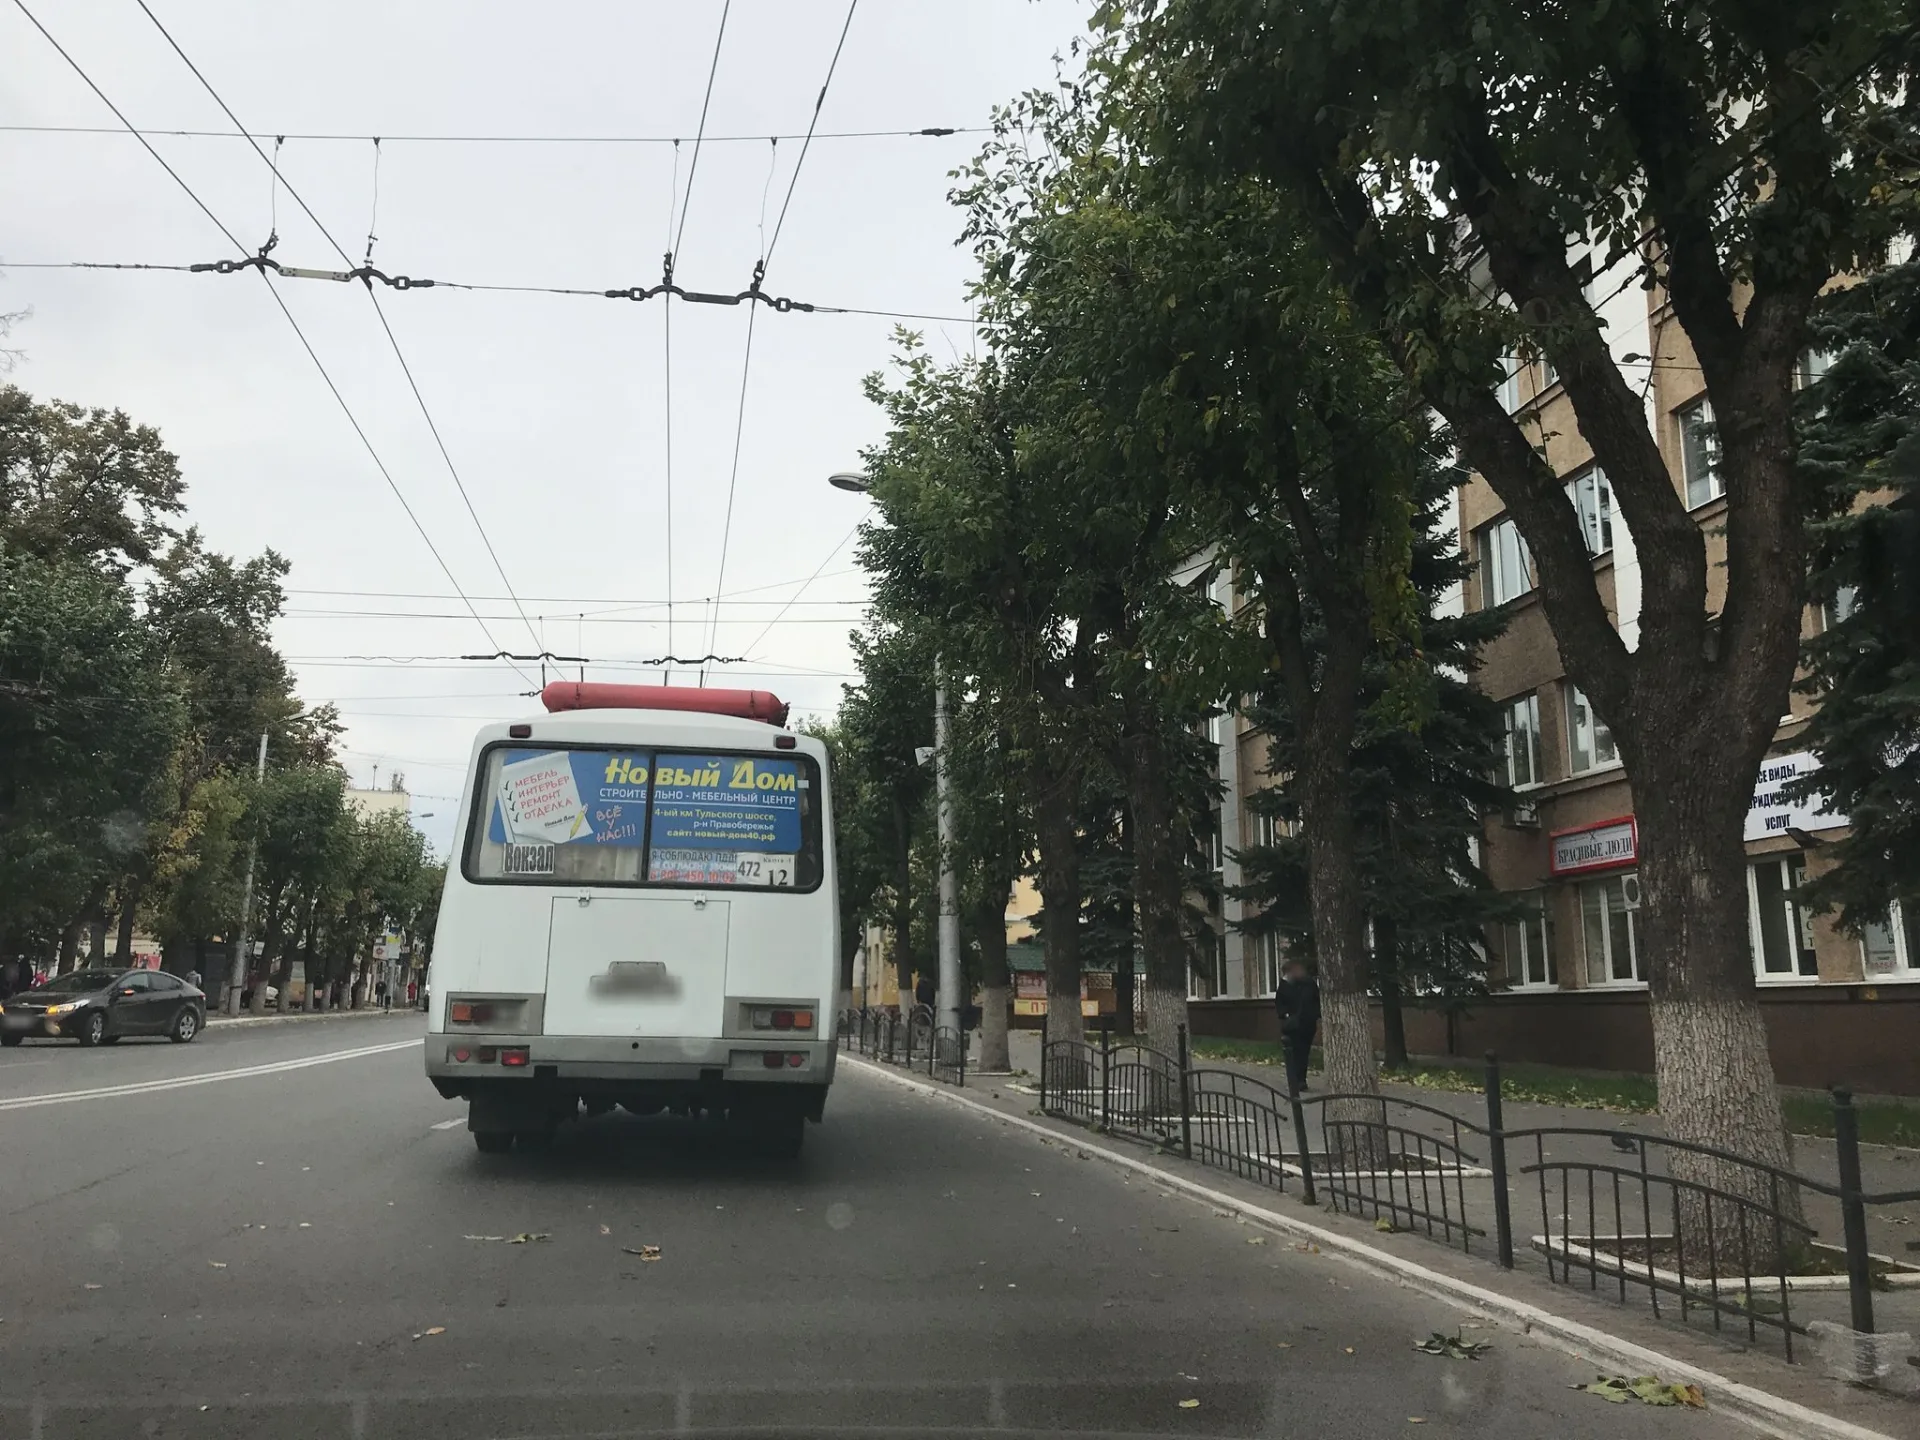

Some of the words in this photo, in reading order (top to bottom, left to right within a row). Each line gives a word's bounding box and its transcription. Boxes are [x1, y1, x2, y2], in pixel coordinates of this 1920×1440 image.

[515, 769, 558, 788] МЕБЕЛЬ
[605, 758, 720, 788] Новый
[728, 761, 796, 792] Дом
[1756, 771, 1768, 784] СЕ
[1768, 763, 1797, 781] ВИДЫ
[518, 776, 570, 798] ИНТЕРЬЕР
[600, 787, 684, 800] СТРОИТЕЛЬНО
[692, 791, 758, 803] МЕБЕЛЬНЫЙ
[762, 794, 796, 806] ЦЕНТР
[520, 790, 561, 809] РЕМОНТ
[524, 798, 573, 820] ОТДЕЛКА
[606, 819, 614, 829] У
[654, 809, 677, 818] 4-ый
[680, 810, 693, 818] км
[694, 809, 743, 821] Тульского
[745, 813, 777, 822] шоссе,
[1764, 814, 1791, 831] УСЛУГ
[596, 824, 637, 843] НАС!!!
[693, 820, 708, 829] р-н
[709, 820, 774, 831] Правобережье
[694, 831, 776, 841] новый-дом40.рф
[504, 843, 554, 872] Вокзал
[651, 850, 657, 860] Я
[659, 851, 713, 863] СОБЛЮДАЮ
[1558, 842, 1604, 864] КРАСИВЫЕ
[1605, 837, 1633, 855] ЛЮДИ
[737, 860, 761, 877] 472
[768, 869, 788, 886] 12
